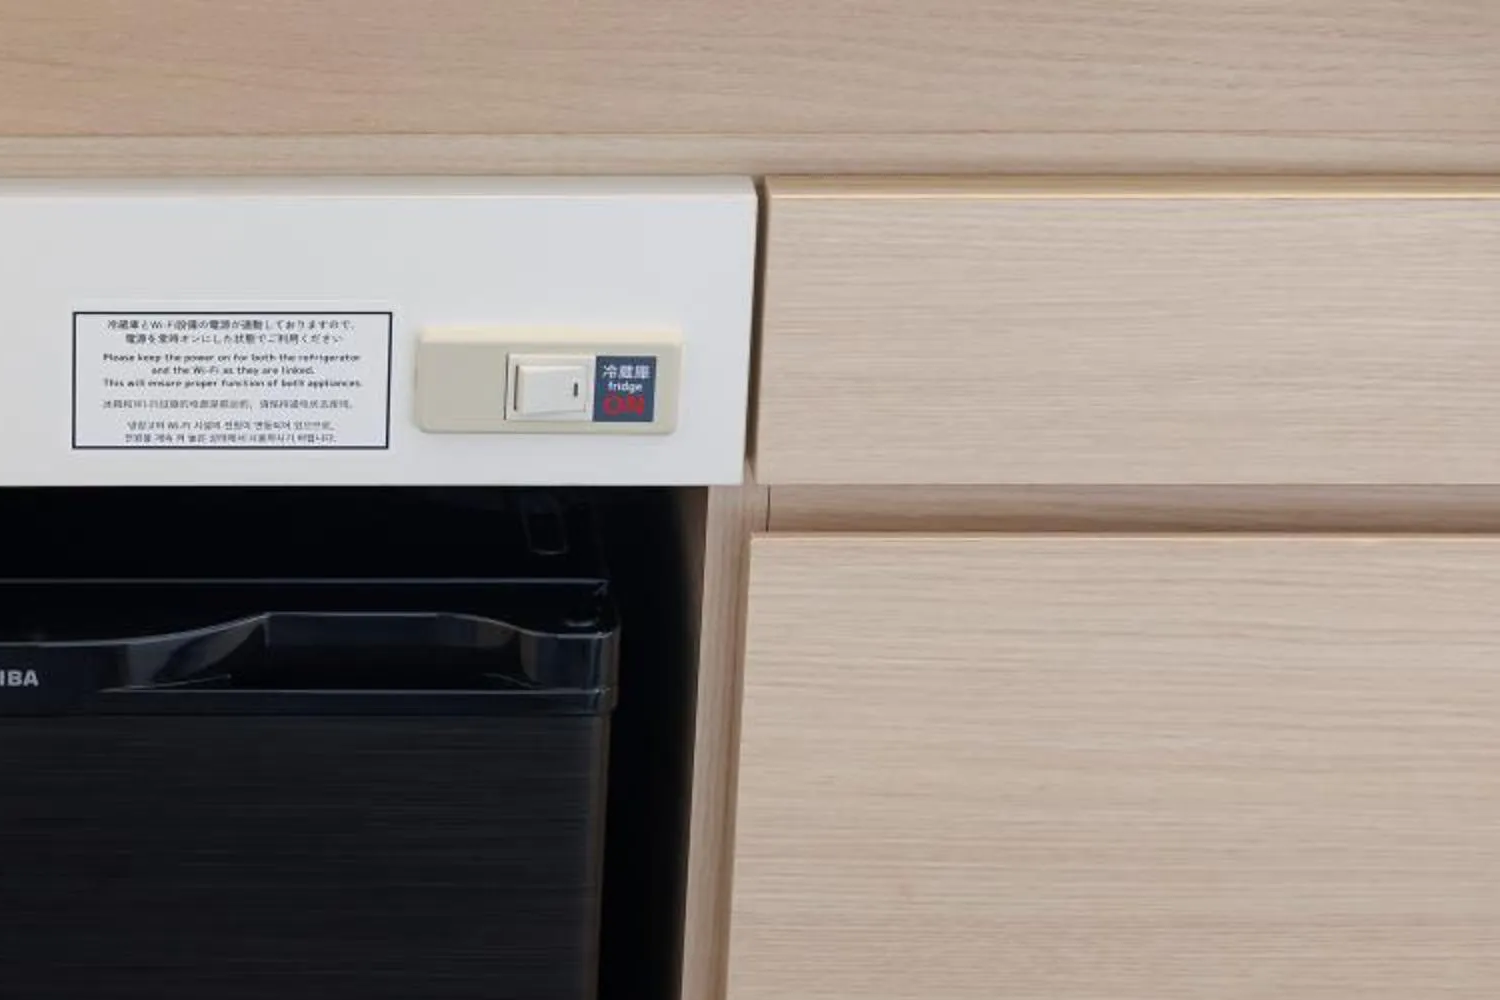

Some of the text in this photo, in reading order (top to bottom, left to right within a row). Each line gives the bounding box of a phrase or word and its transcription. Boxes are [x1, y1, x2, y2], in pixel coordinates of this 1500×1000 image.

[103, 353, 135, 361] Please
[137, 353, 162, 362] keep
[164, 353, 182, 361] the
[184, 354, 214, 362] power
[233, 353, 248, 361] for
[251, 353, 277, 361] both
[279, 353, 296, 361] the
[298, 353, 360, 363] refrigerator
[151, 366, 170, 374] and
[173, 366, 190, 374] the
[192, 366, 220, 374] Wi-Fi
[237, 366, 259, 375] they
[280, 366, 316, 374] linked.
[602, 364, 652, 379] 冷蔵庫
[103, 379, 125, 387] This
[127, 379, 146, 387] will
[184, 380, 217, 388] proper
[220, 379, 264, 387] function
[266, 379, 278, 387] of
[280, 379, 305, 387] both
[307, 379, 362, 389] appliances.
[607, 380, 643, 393] fridge
[602, 393, 645, 416] ON
